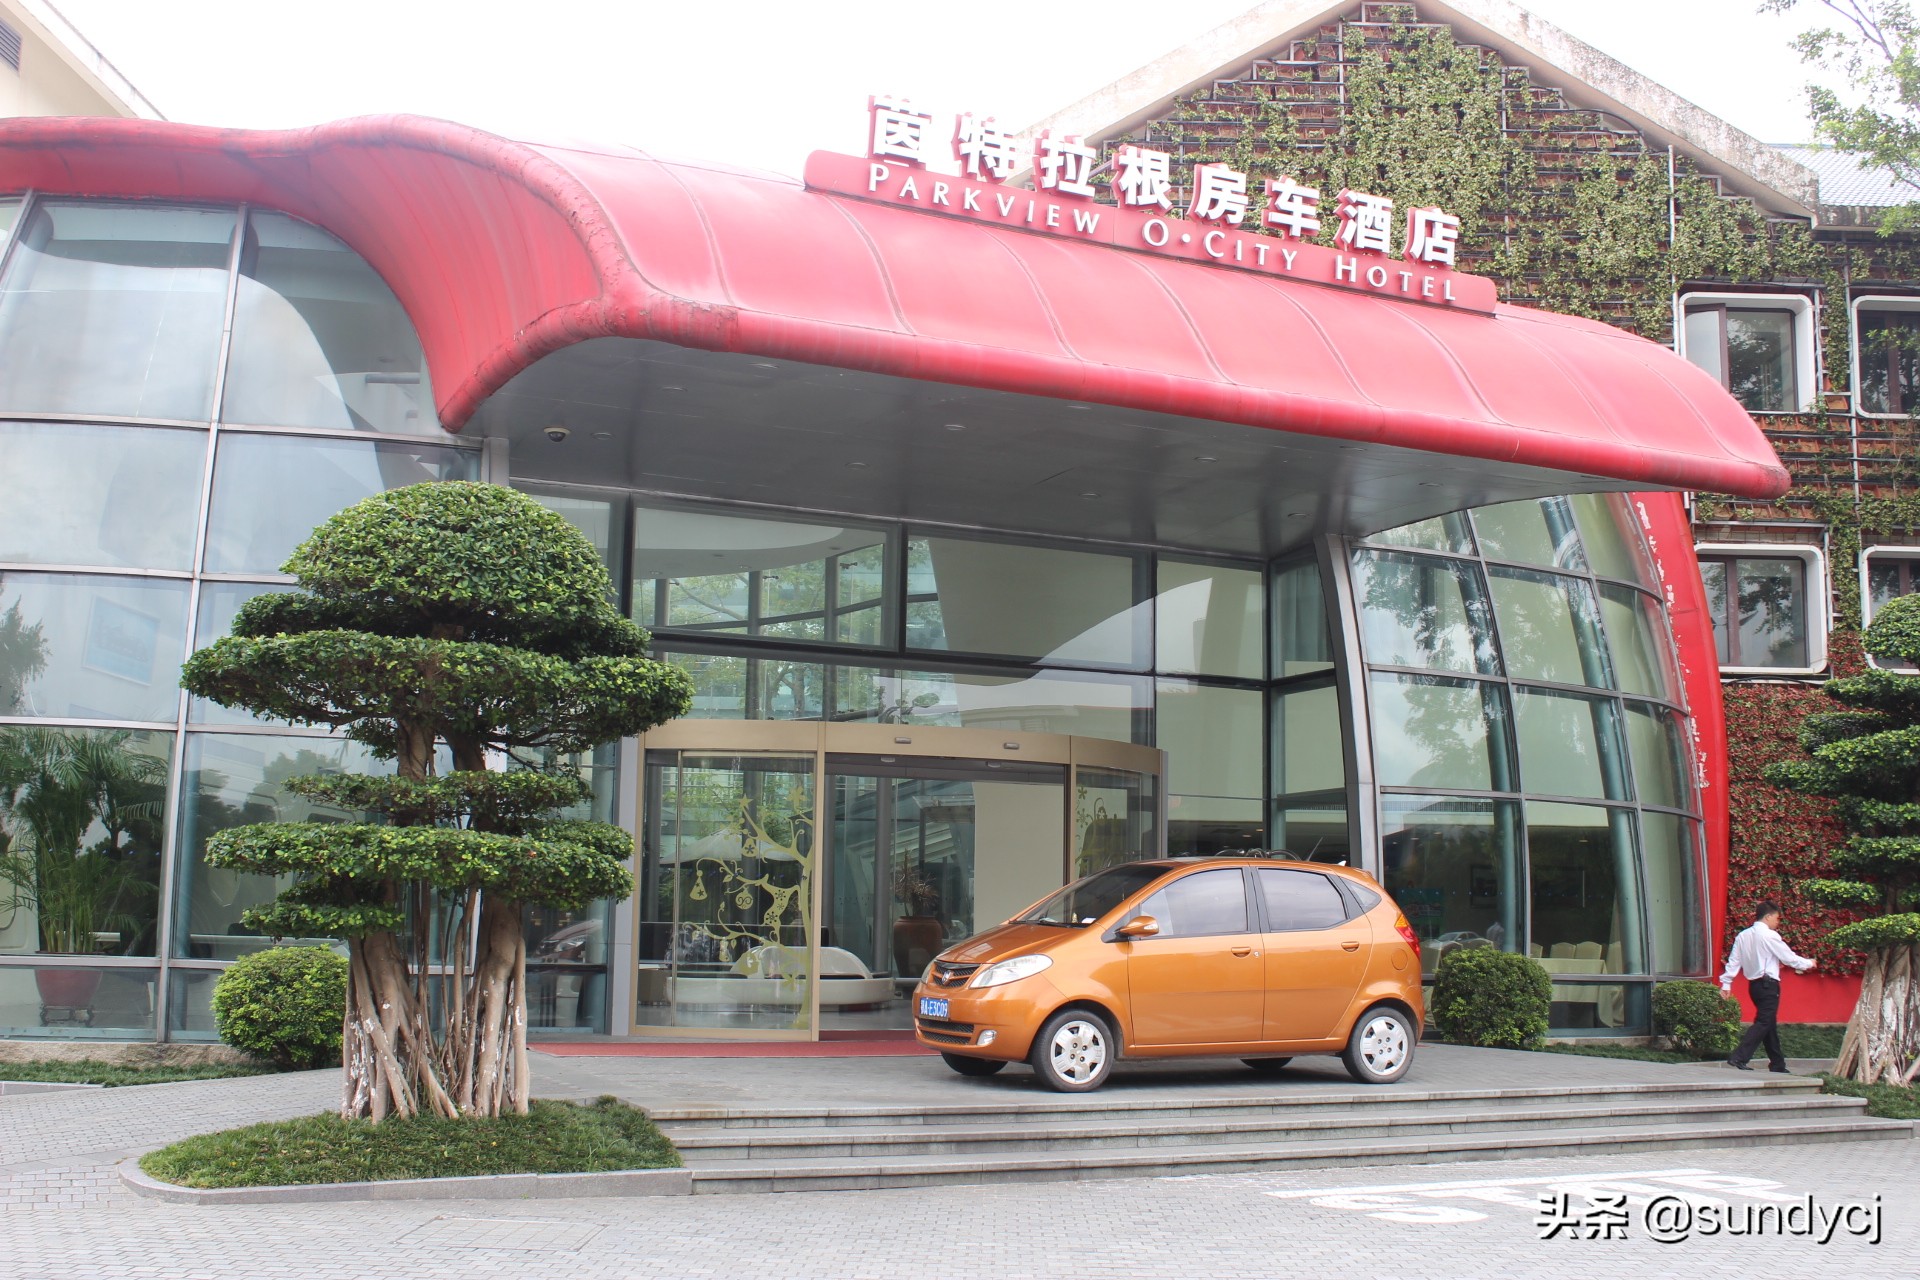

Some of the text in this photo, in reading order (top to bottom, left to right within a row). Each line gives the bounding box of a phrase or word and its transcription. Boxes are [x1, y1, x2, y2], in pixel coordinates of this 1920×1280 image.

[867, 95, 1460, 266] 茵特拉根房车酒店
[868, 162, 1101, 235] PARKVIEW
[1334, 254, 1456, 302] HOTEL
[1308, 1175, 1806, 1224] STOP
